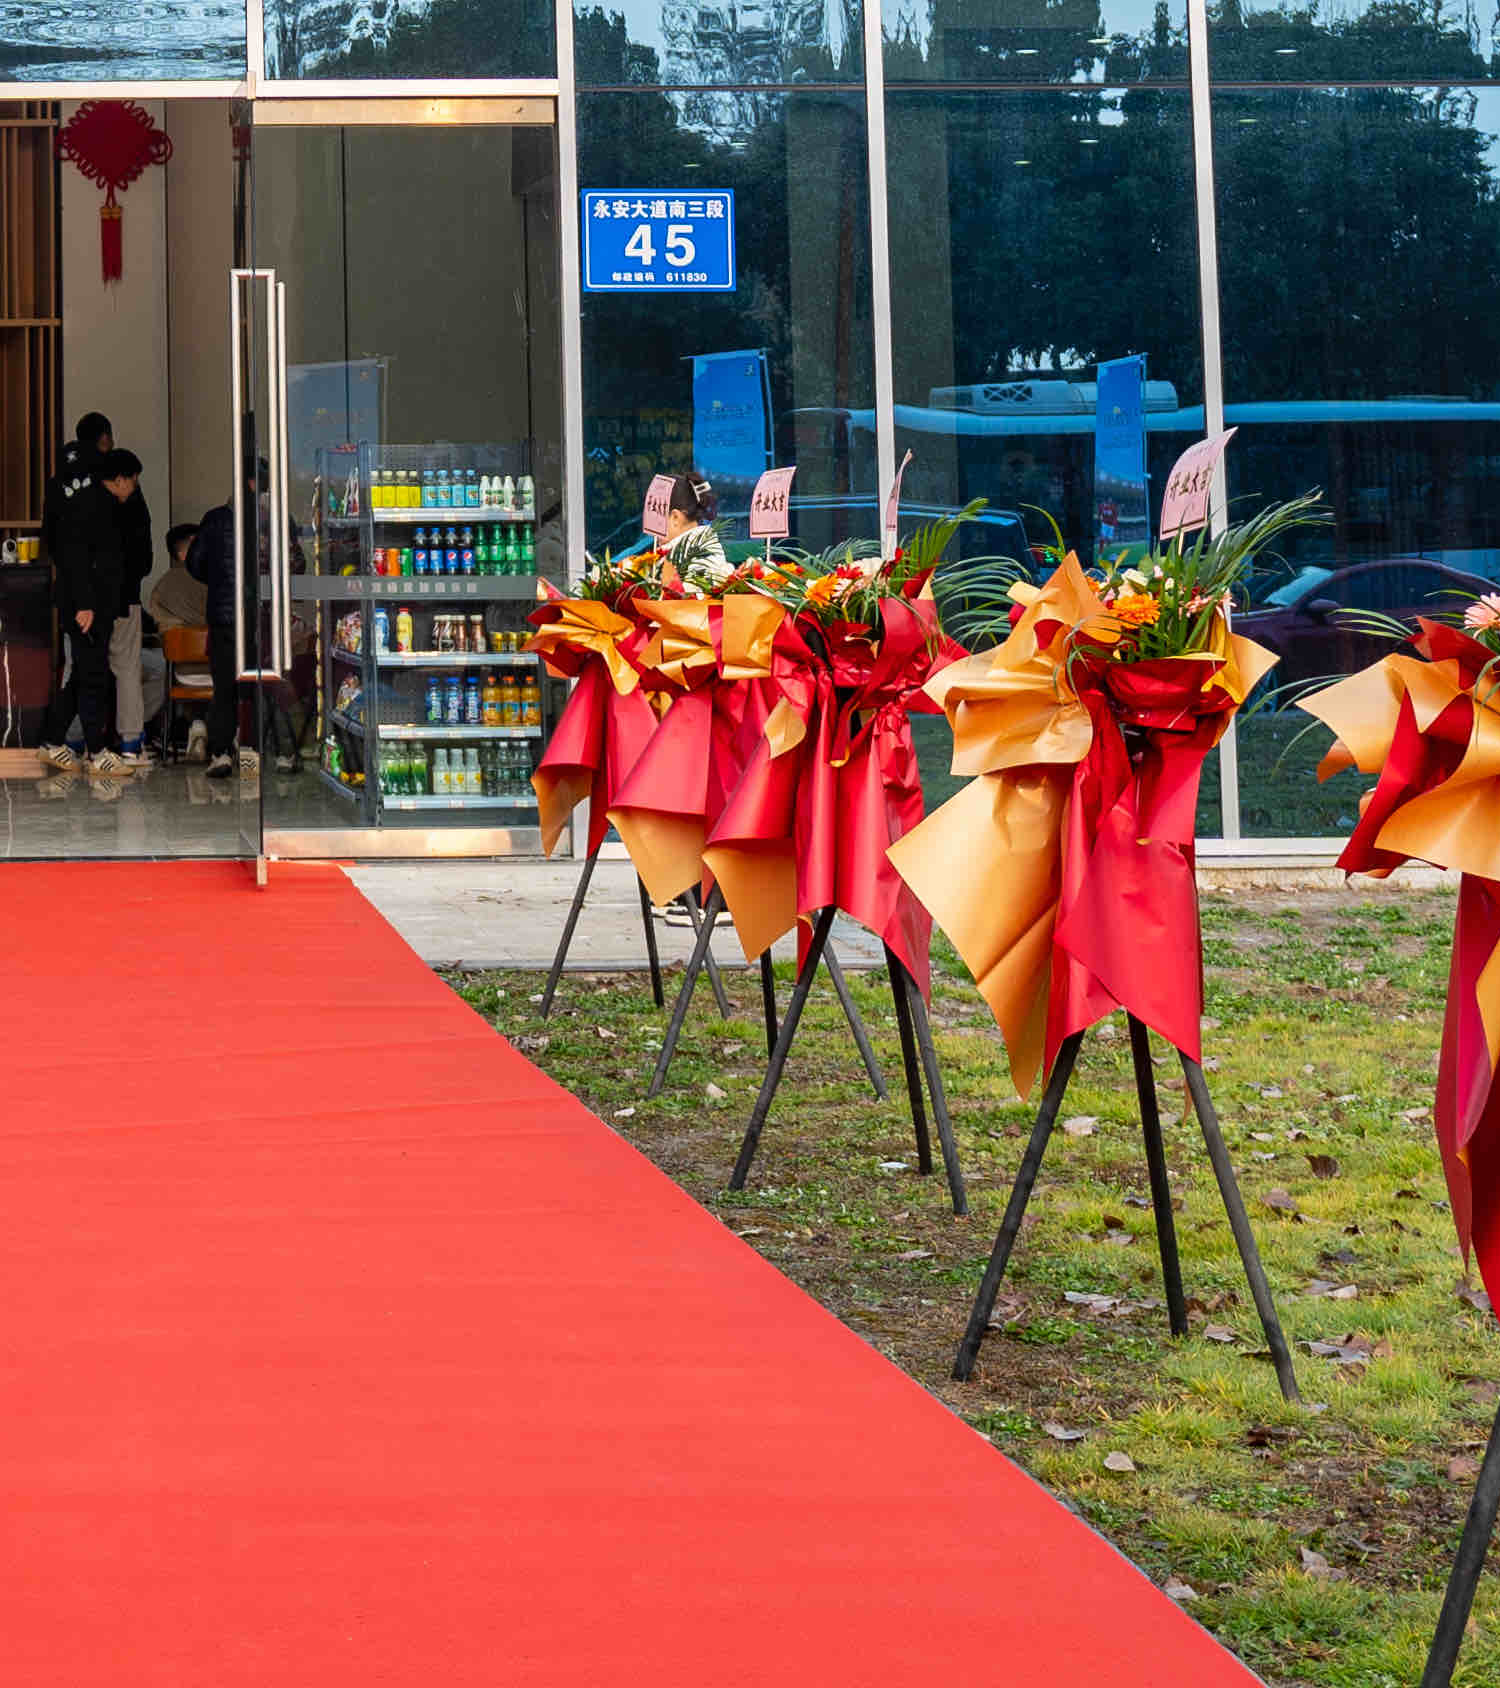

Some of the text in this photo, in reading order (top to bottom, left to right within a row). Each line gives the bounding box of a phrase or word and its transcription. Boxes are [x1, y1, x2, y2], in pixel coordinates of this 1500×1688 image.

[593, 200, 725, 219] 永安大道南三段
[624, 224, 696, 266] 45
